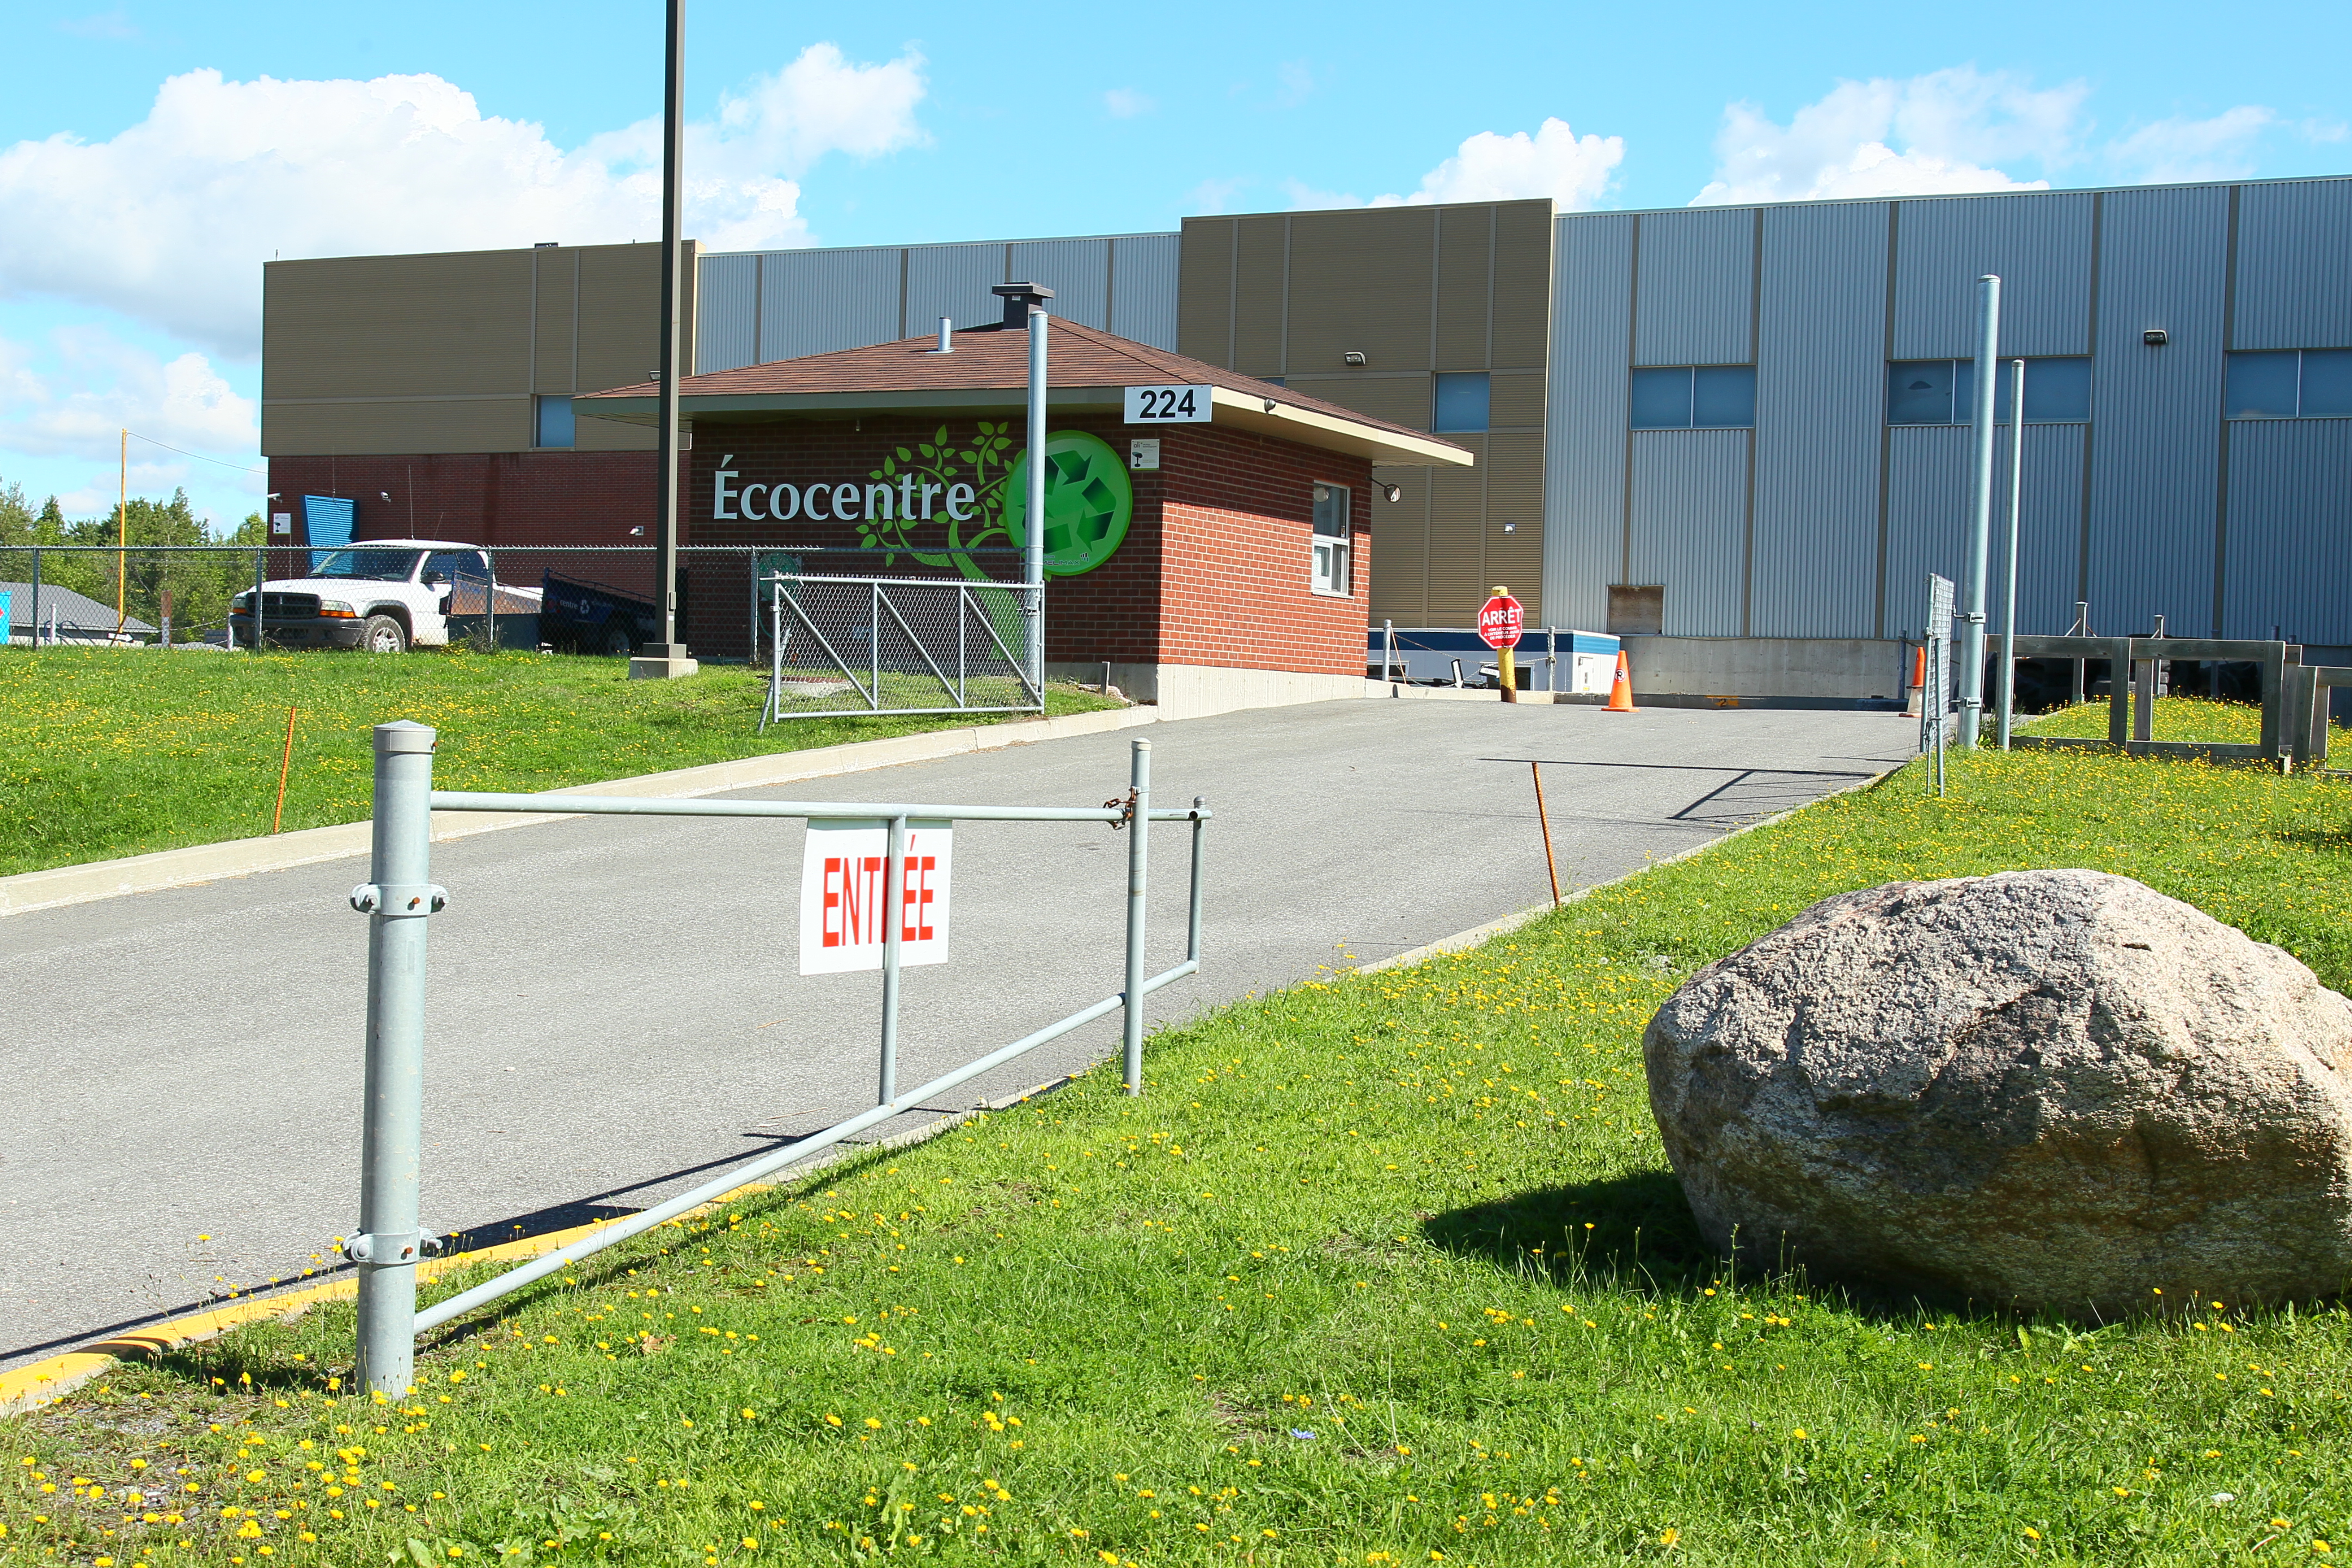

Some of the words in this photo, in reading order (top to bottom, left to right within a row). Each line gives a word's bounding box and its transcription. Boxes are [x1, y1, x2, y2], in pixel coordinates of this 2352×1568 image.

[1140, 389, 1196, 418] 224
[714, 455, 975, 520] Écocentre
[1481, 606, 1521, 626] ARRÊT
[1720, 699, 1726, 707] 2
